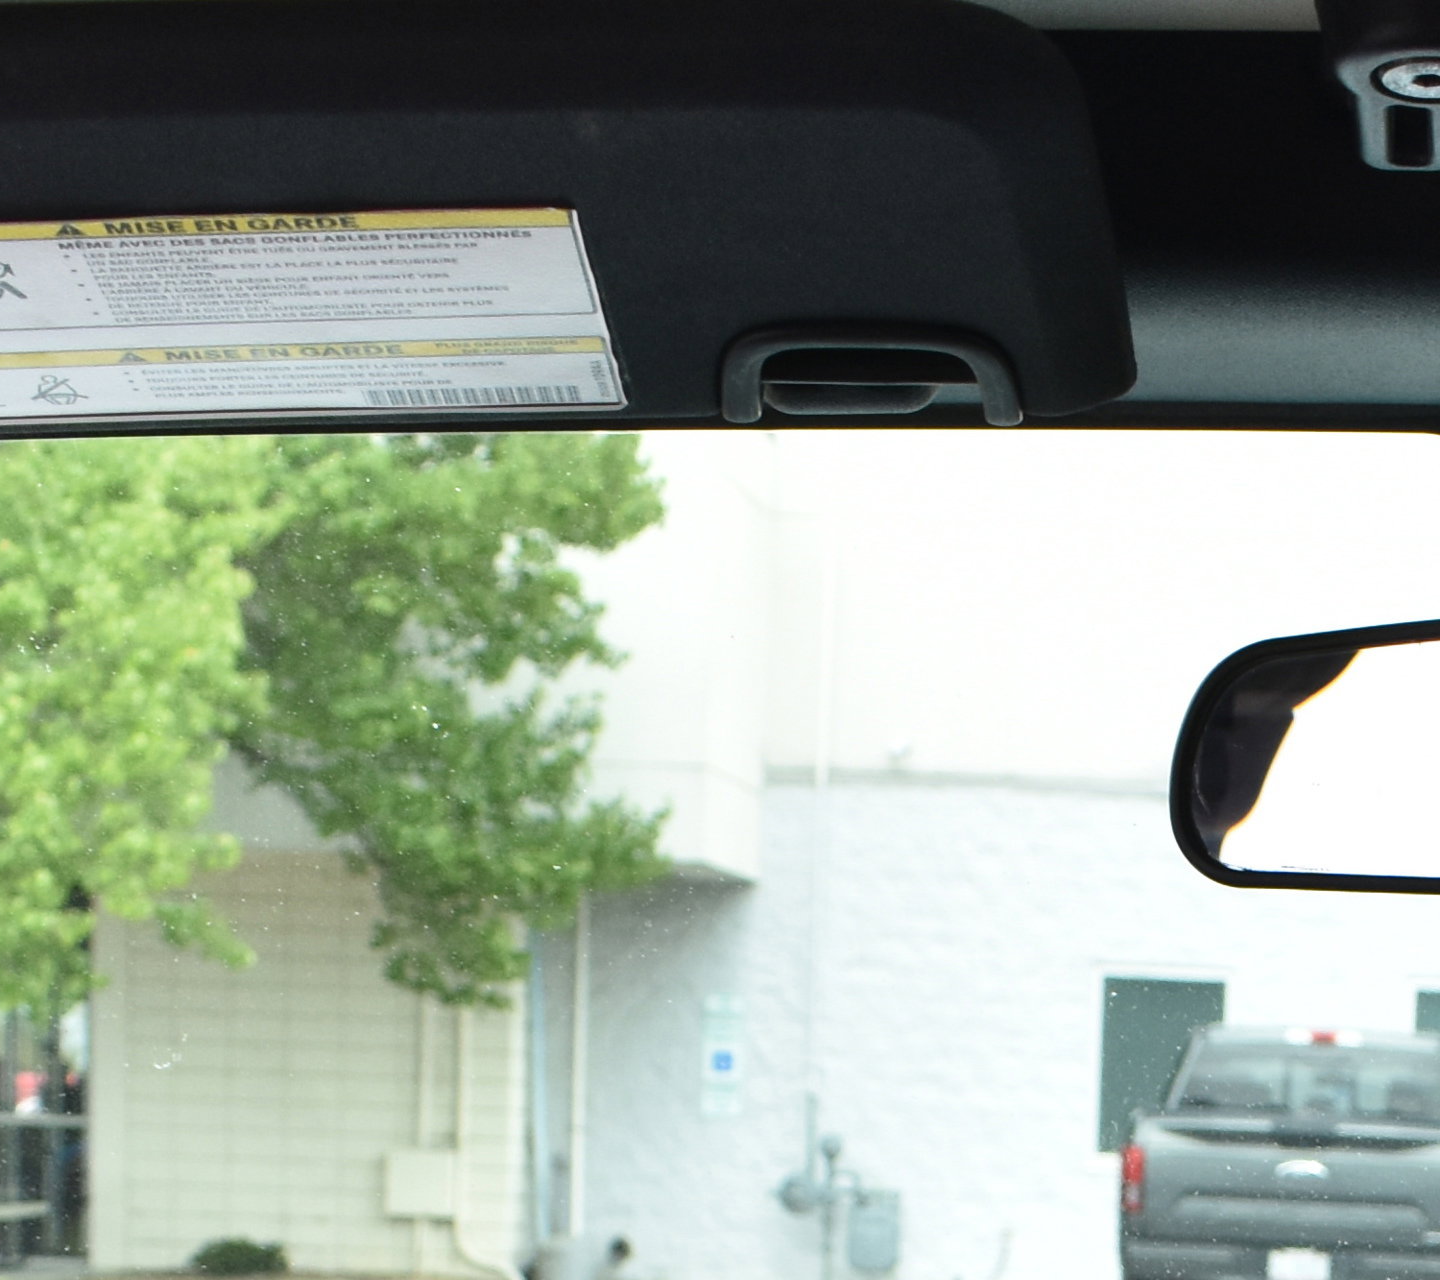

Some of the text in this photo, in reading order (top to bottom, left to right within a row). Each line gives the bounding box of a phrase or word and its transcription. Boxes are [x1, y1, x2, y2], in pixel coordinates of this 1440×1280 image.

[104, 216, 358, 234] MISE EN GARDE
[58, 230, 532, 250] MÊME AVEC DES SACS GONFLABLES PERFECTIONNÉS
[166, 345, 402, 361] MISE EN GARDE
